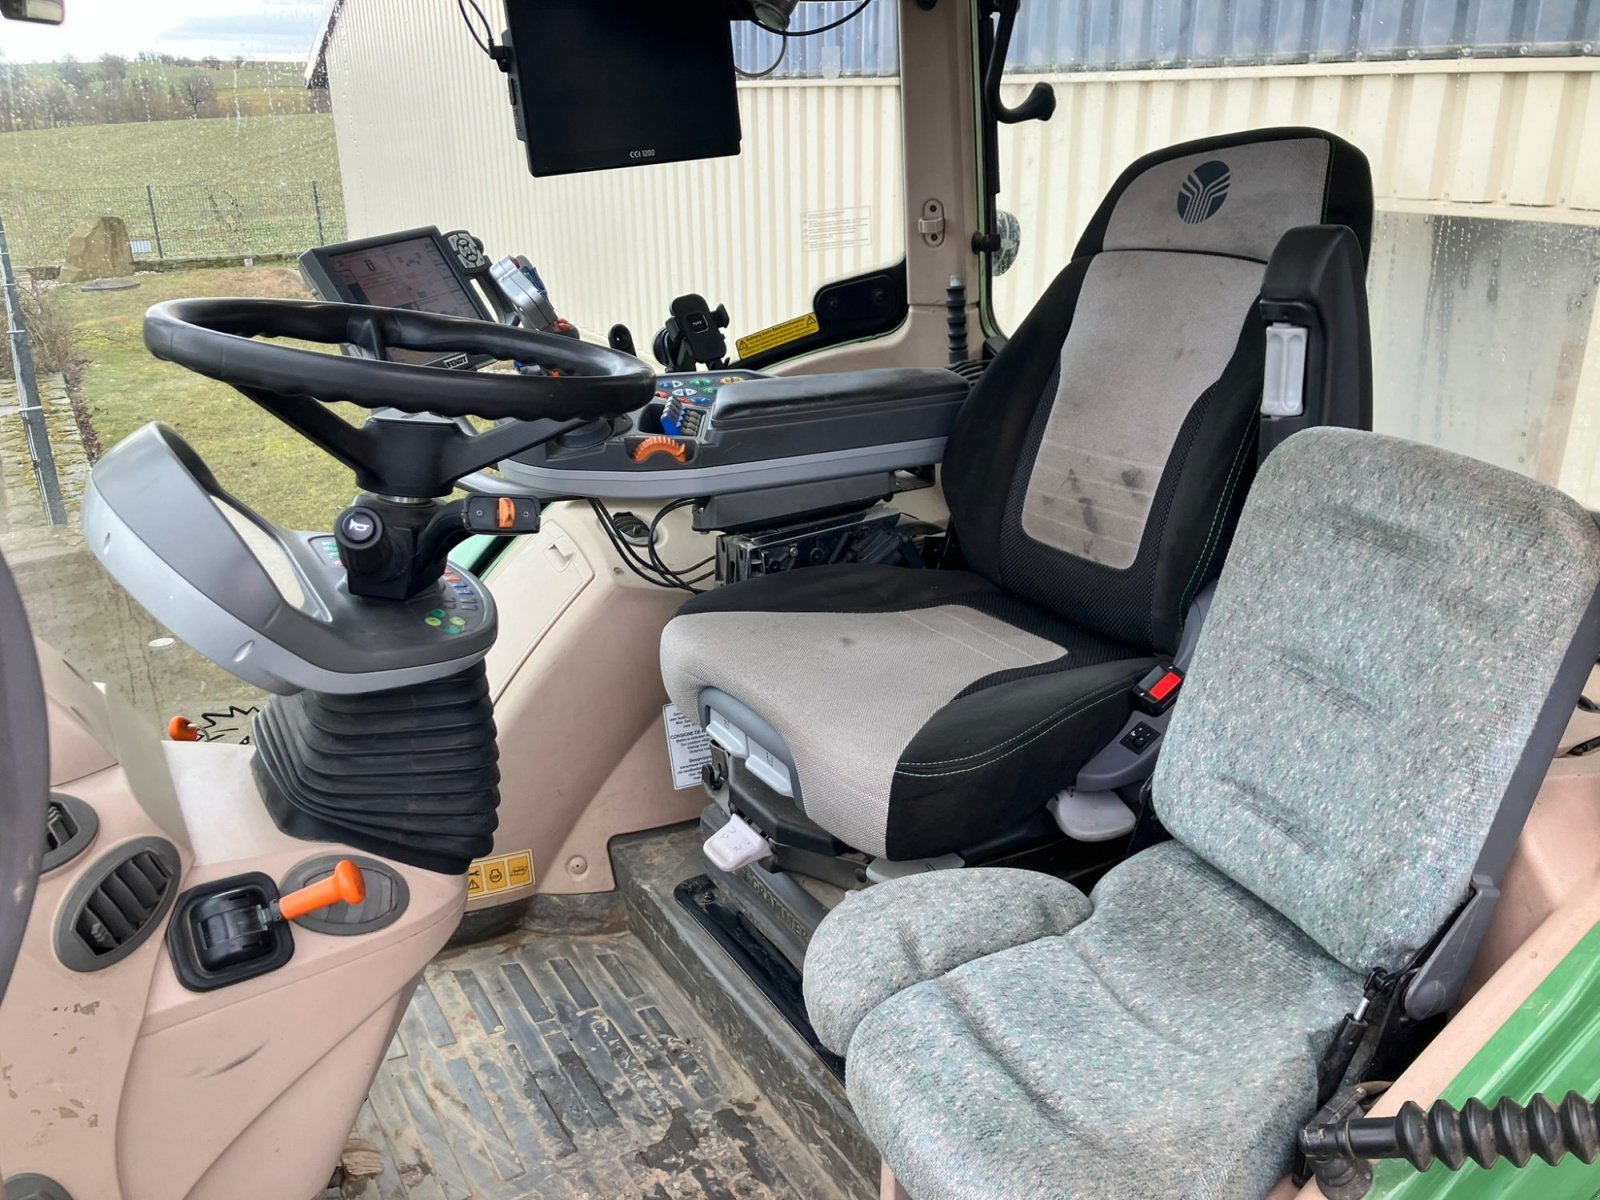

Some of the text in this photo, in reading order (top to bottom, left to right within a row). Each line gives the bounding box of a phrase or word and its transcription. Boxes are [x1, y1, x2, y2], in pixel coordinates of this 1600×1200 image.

[629, 148, 656, 158] CCI 1200
[446, 356, 466, 368] FENDT
[670, 731, 694, 740] CONSIGNE
